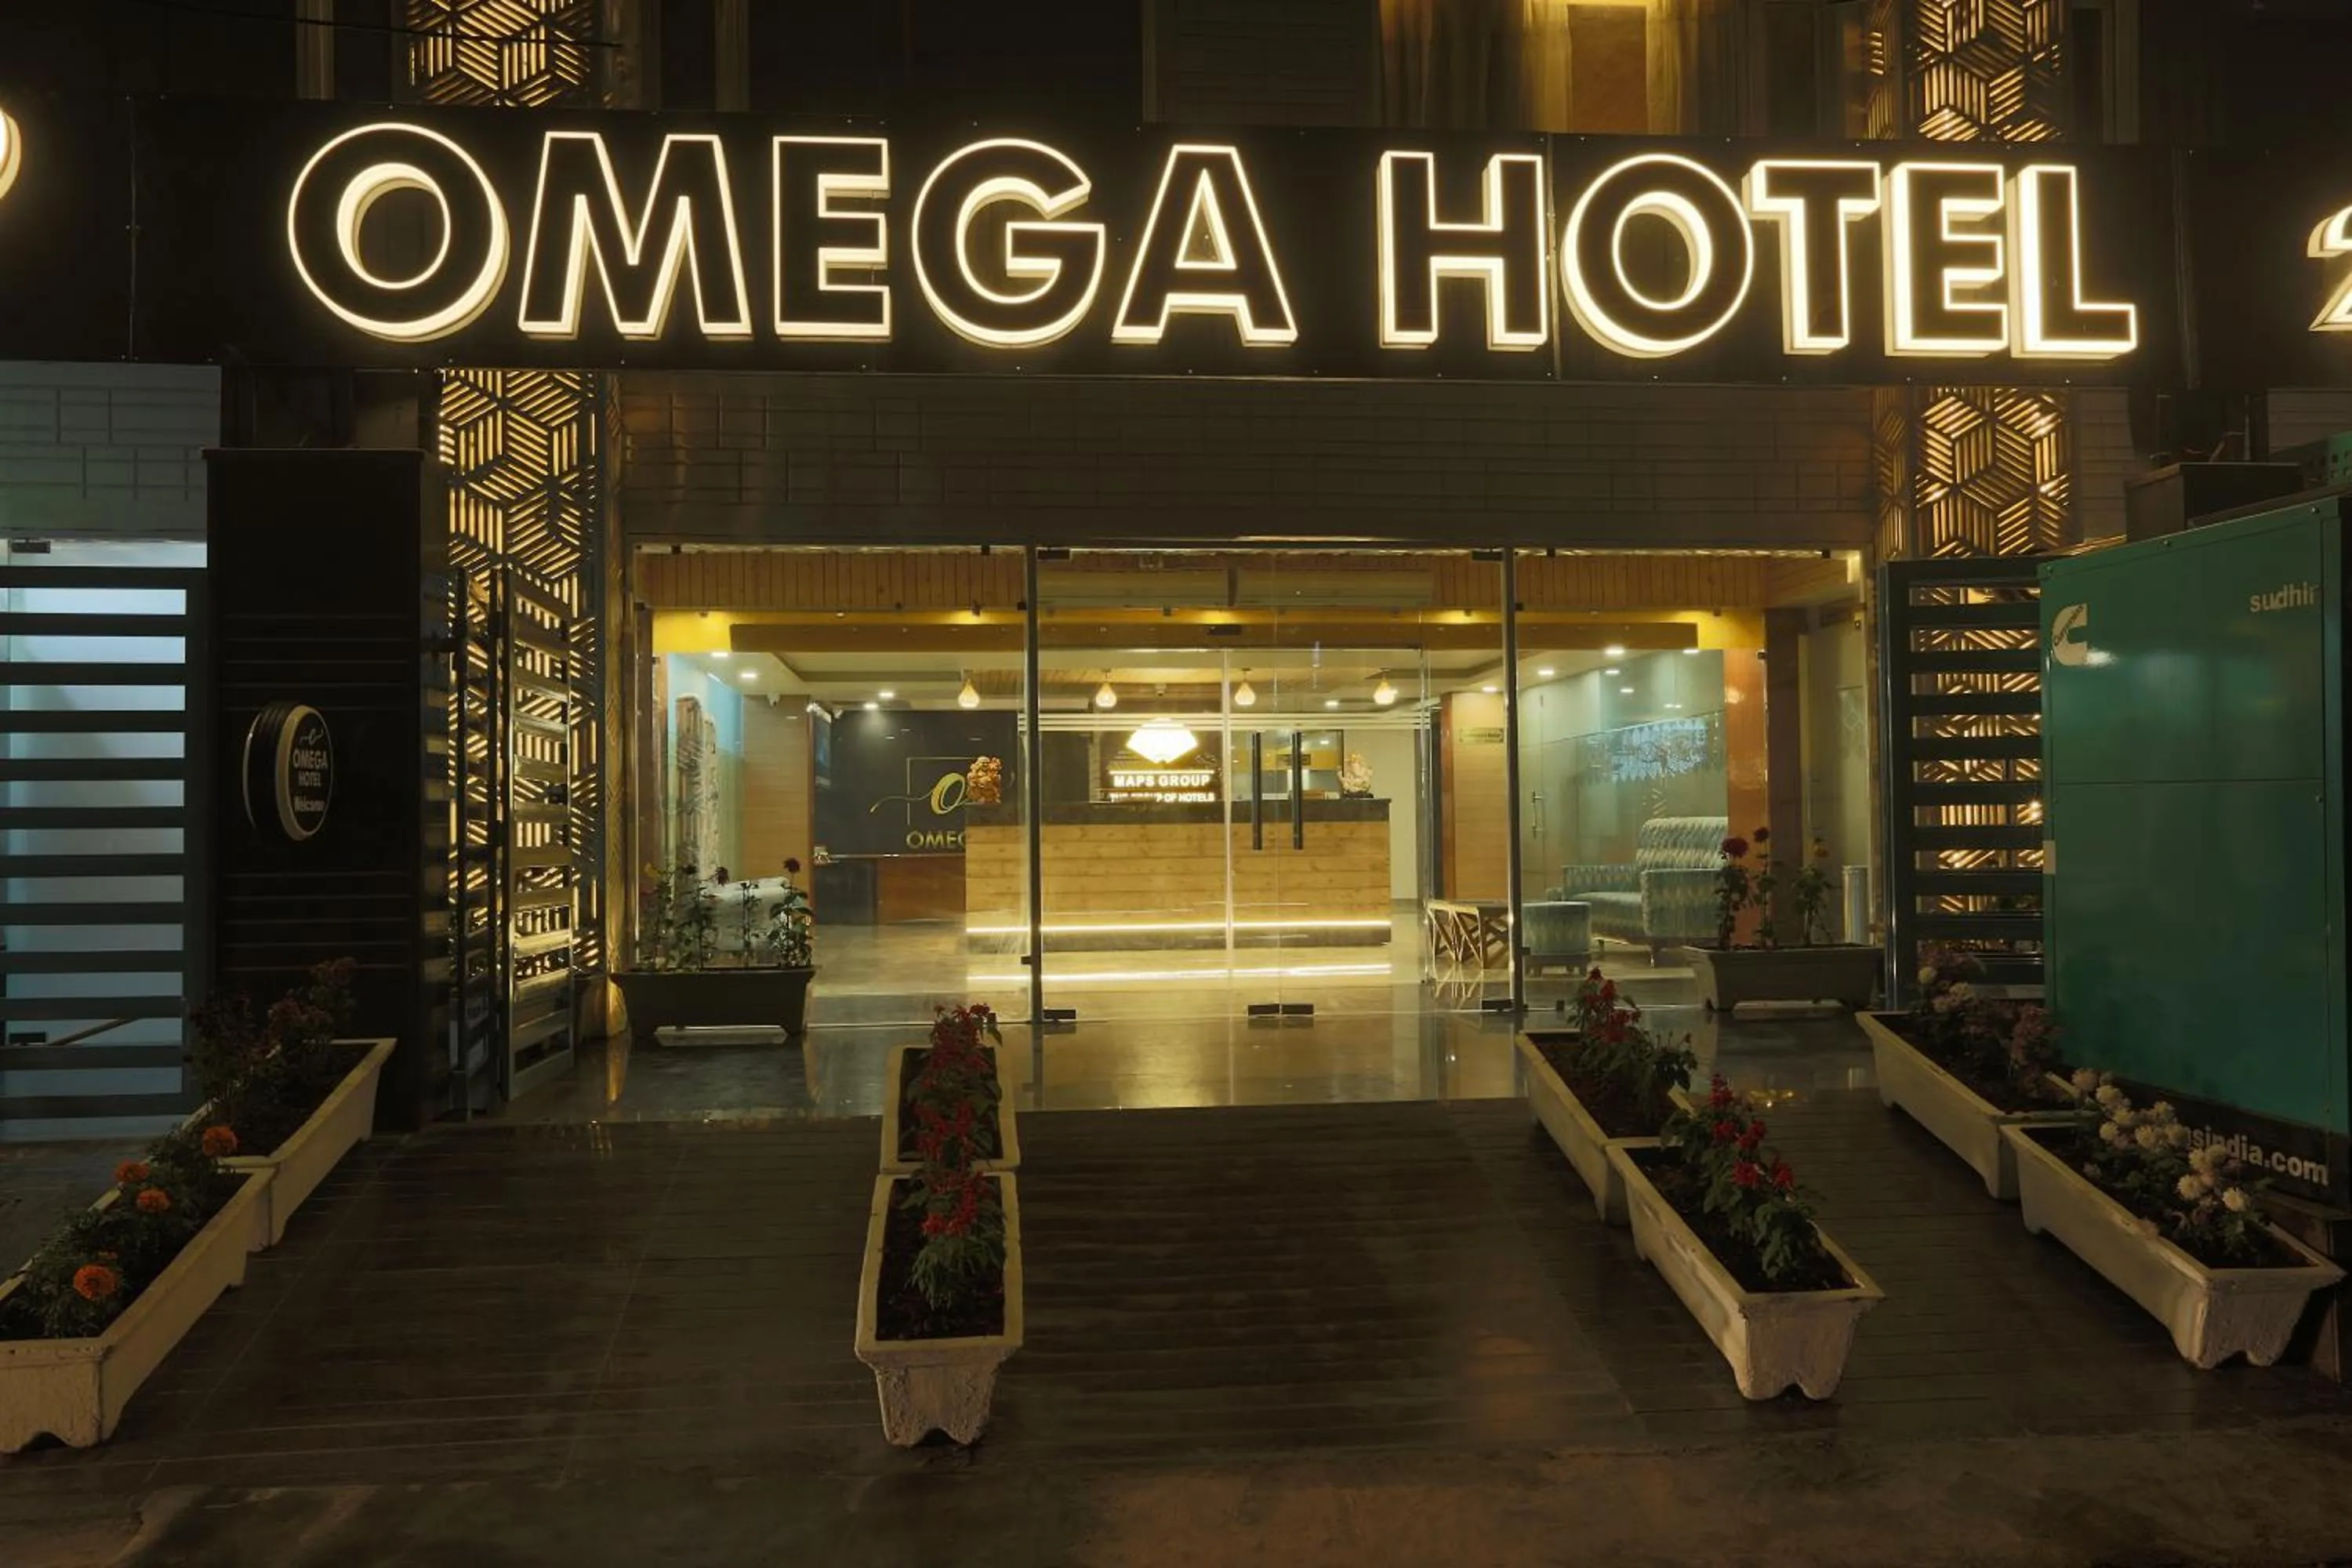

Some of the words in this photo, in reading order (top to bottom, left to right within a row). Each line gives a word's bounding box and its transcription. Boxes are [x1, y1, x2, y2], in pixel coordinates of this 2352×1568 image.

[287, 122, 1298, 347] OMEGA
[1377, 150, 2137, 358] HOTEL
[2249, 581, 2319, 613] sudhir
[293, 749, 328, 770] OMEGA
[298, 771, 321, 787] HOTEL
[1113, 775, 1155, 787] MAPS
[1158, 775, 1210, 787] GROUP
[1178, 793, 1214, 802] HOTELS
